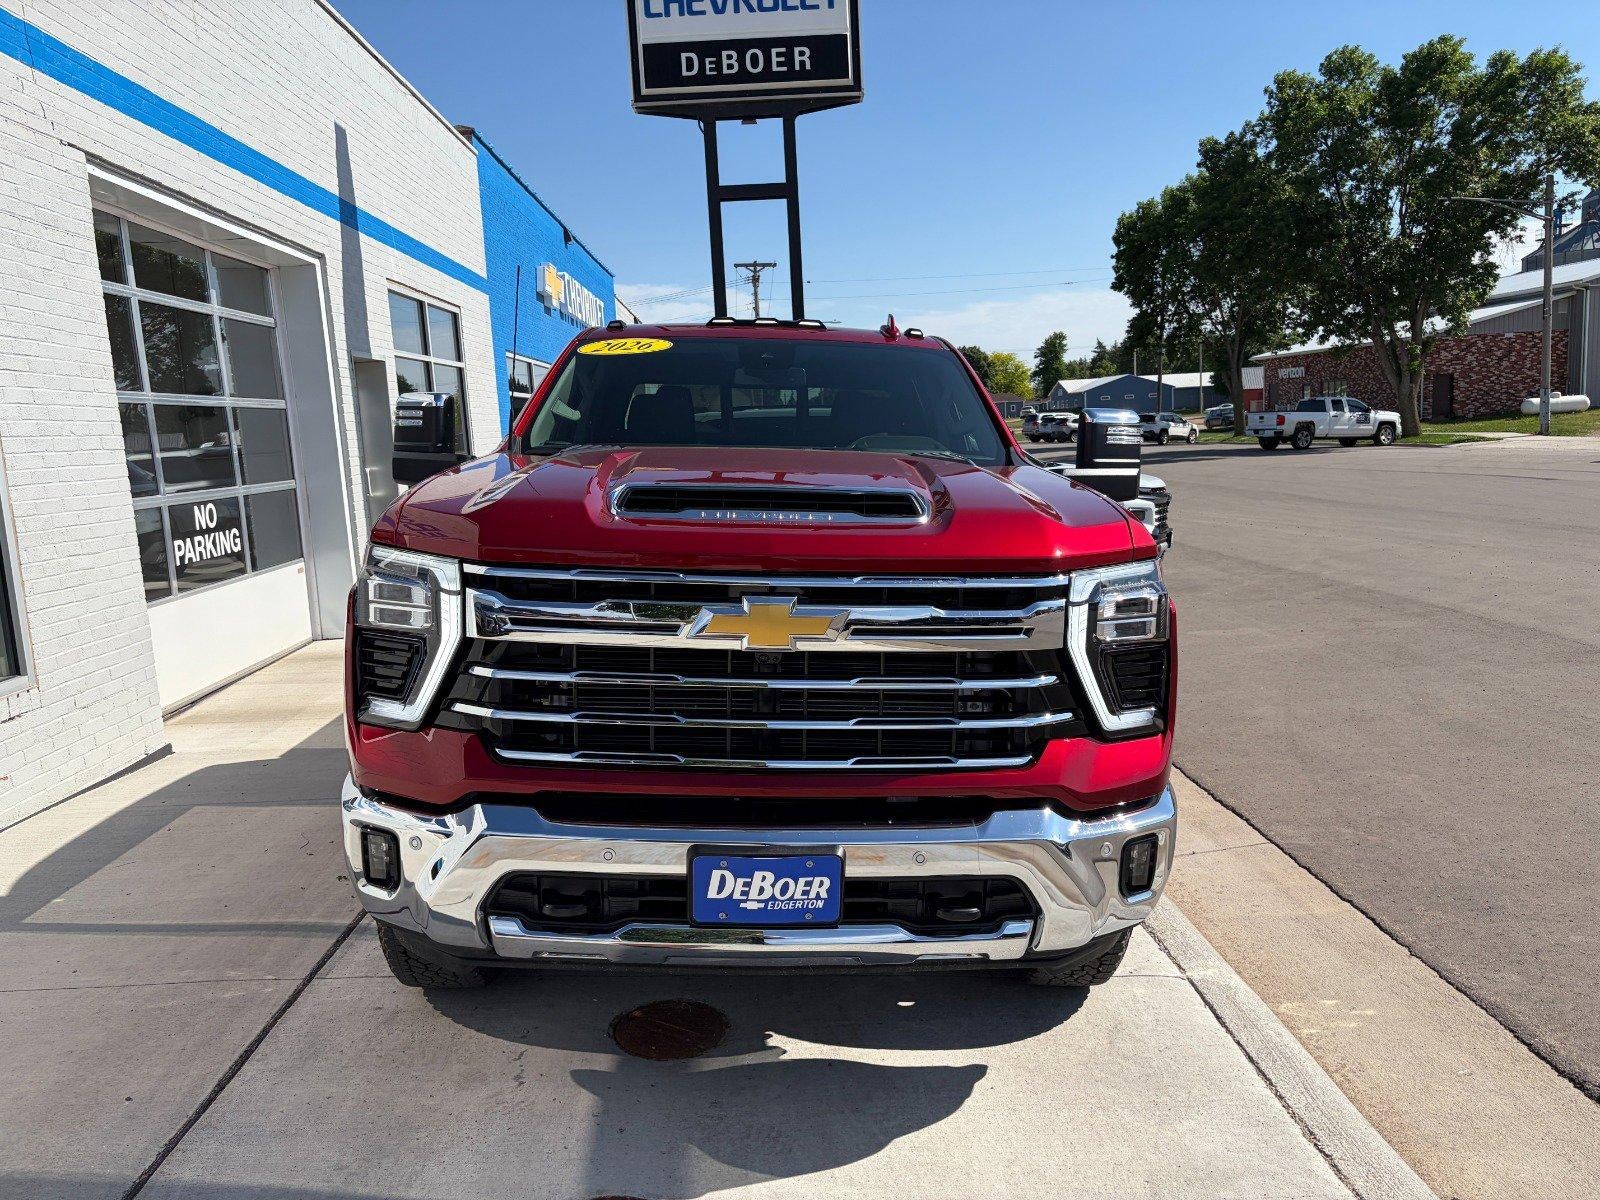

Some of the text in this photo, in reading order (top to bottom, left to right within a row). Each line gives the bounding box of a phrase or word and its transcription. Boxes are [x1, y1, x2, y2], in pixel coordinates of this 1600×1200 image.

[643, 0, 835, 18] CHEVR
[591, 340, 653, 353] 2026
[193, 502, 218, 531] NO
[173, 527, 242, 567] PARKING
[767, 900, 825, 910] EDGERTON
